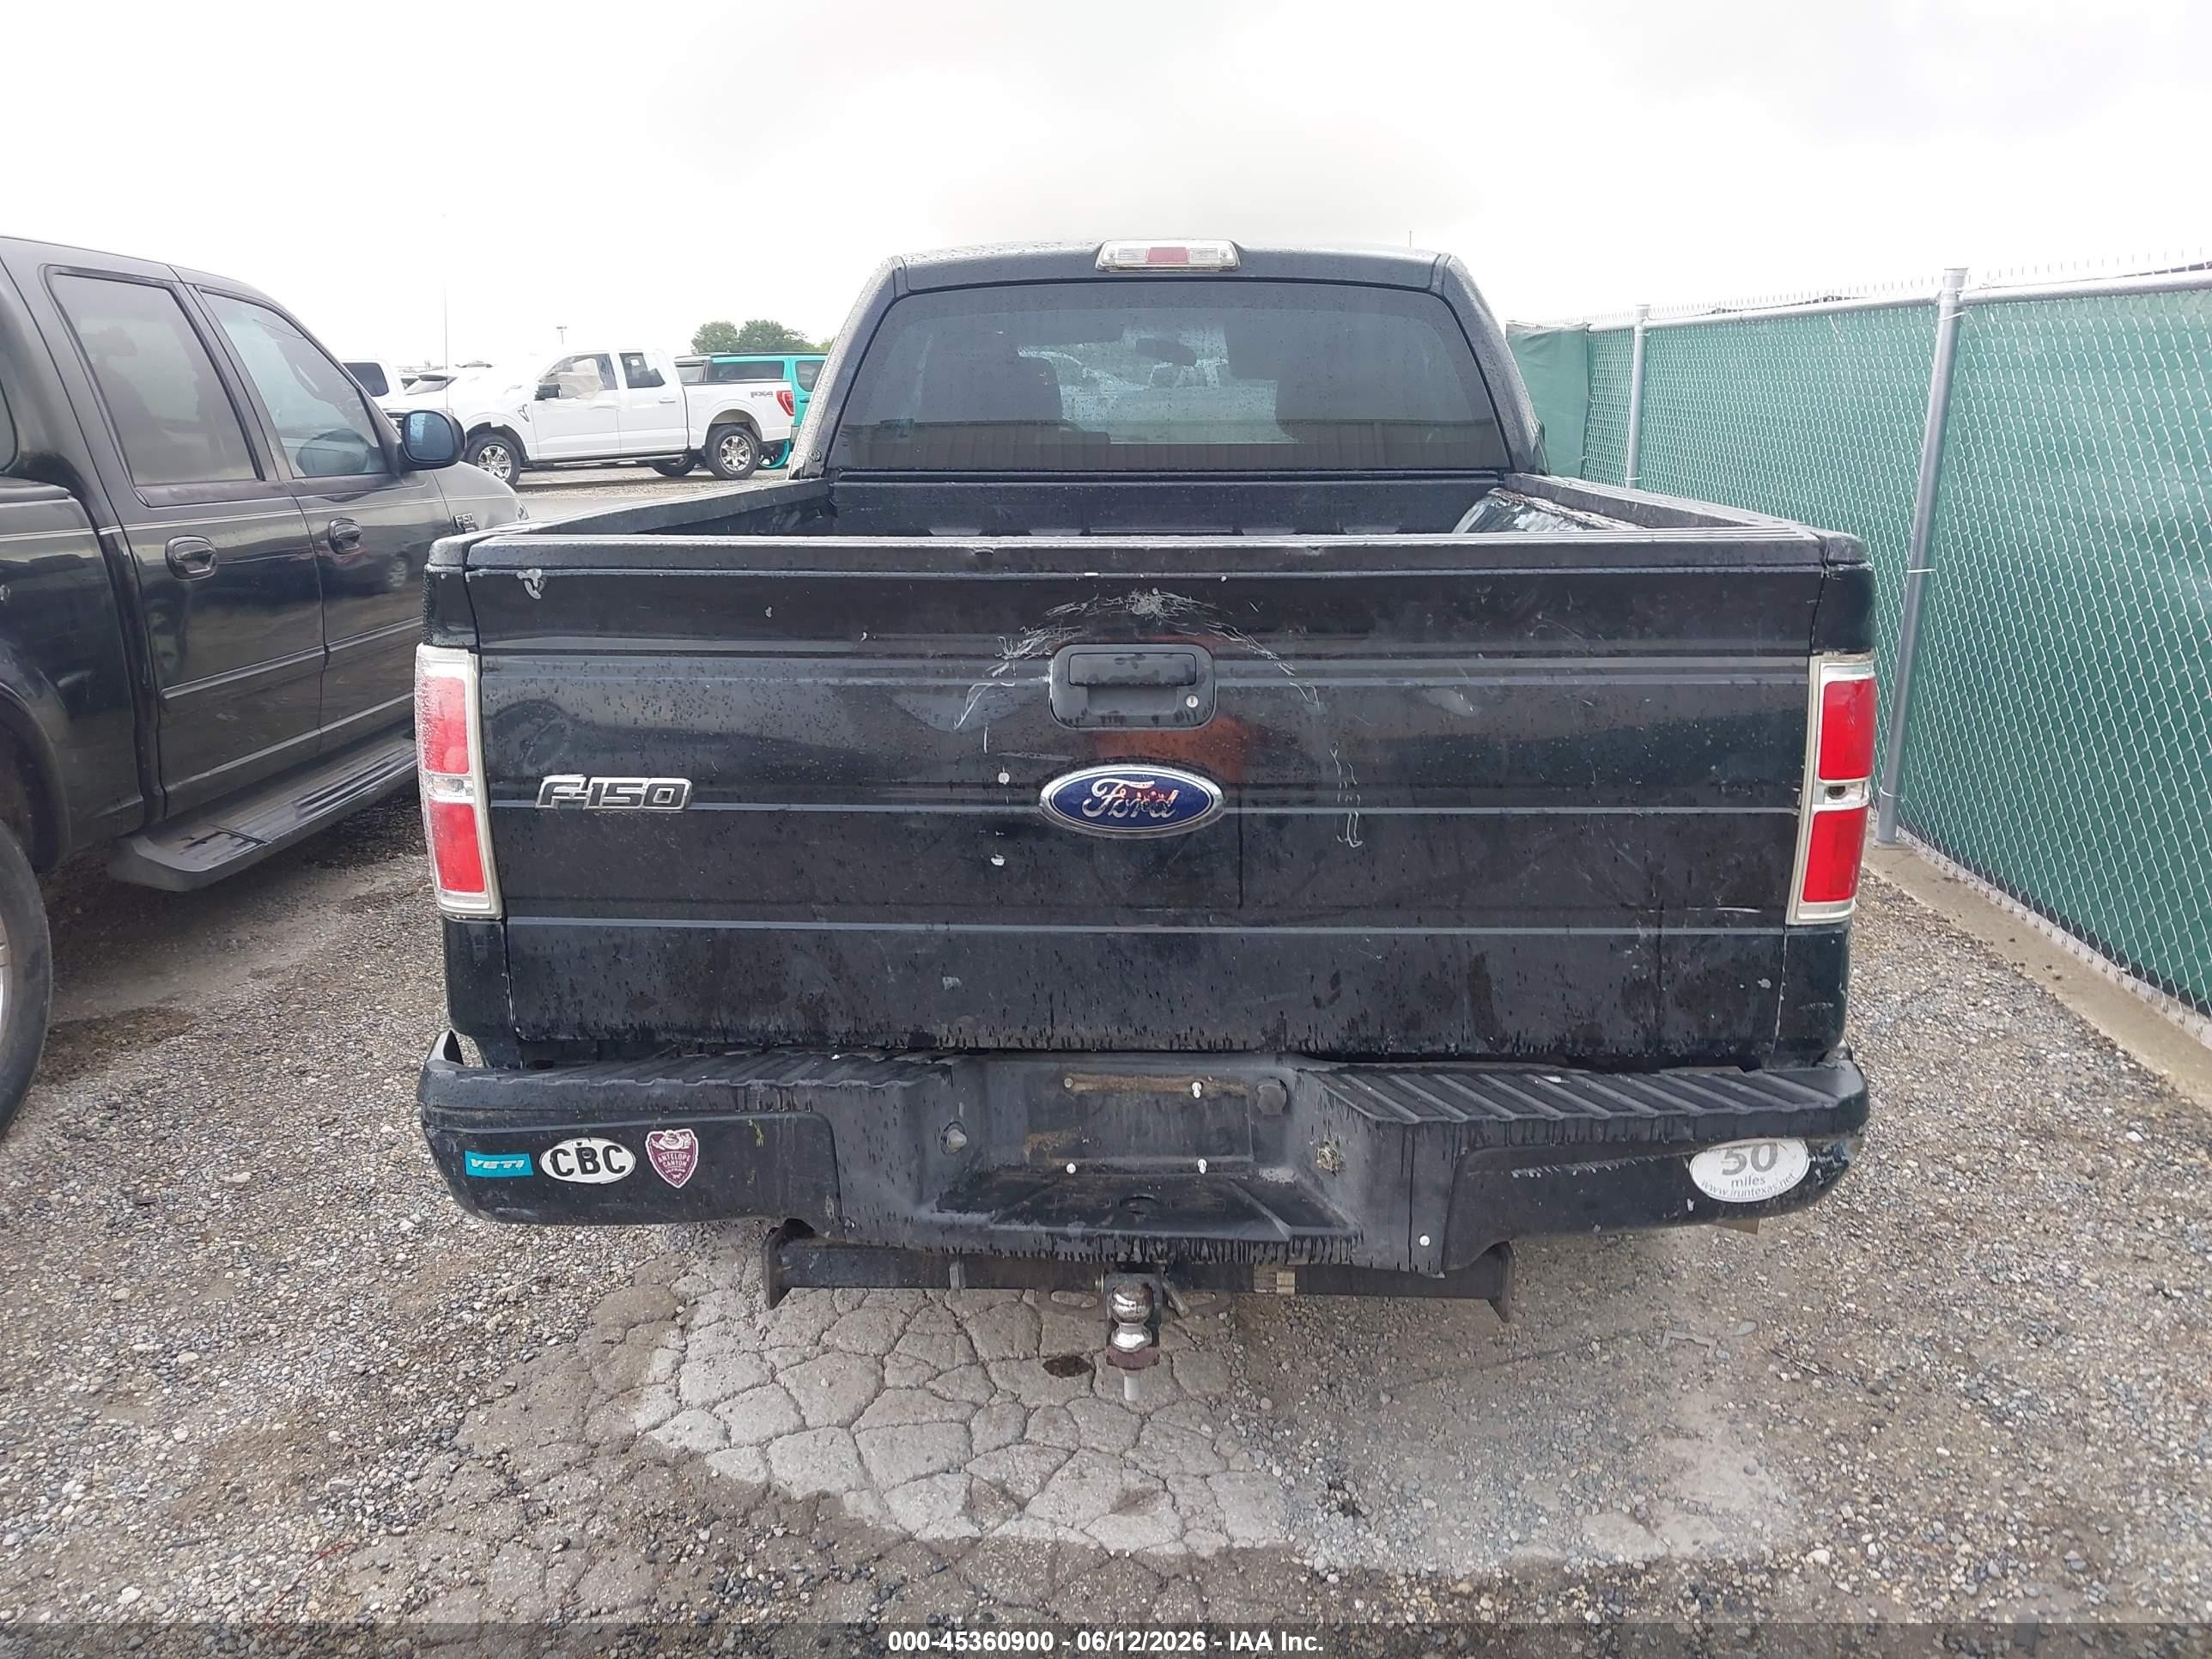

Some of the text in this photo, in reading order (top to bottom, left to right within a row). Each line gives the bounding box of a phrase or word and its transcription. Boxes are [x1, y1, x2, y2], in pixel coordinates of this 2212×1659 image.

[536, 775, 691, 810] F-150
[1082, 779, 1179, 817] Ford
[471, 1158, 525, 1170] YETI
[550, 1145, 626, 1177] CBC
[658, 1153, 691, 1163] ANTELOPE
[1722, 1144, 1778, 1174] 50
[1731, 1173, 1766, 1188] miles
